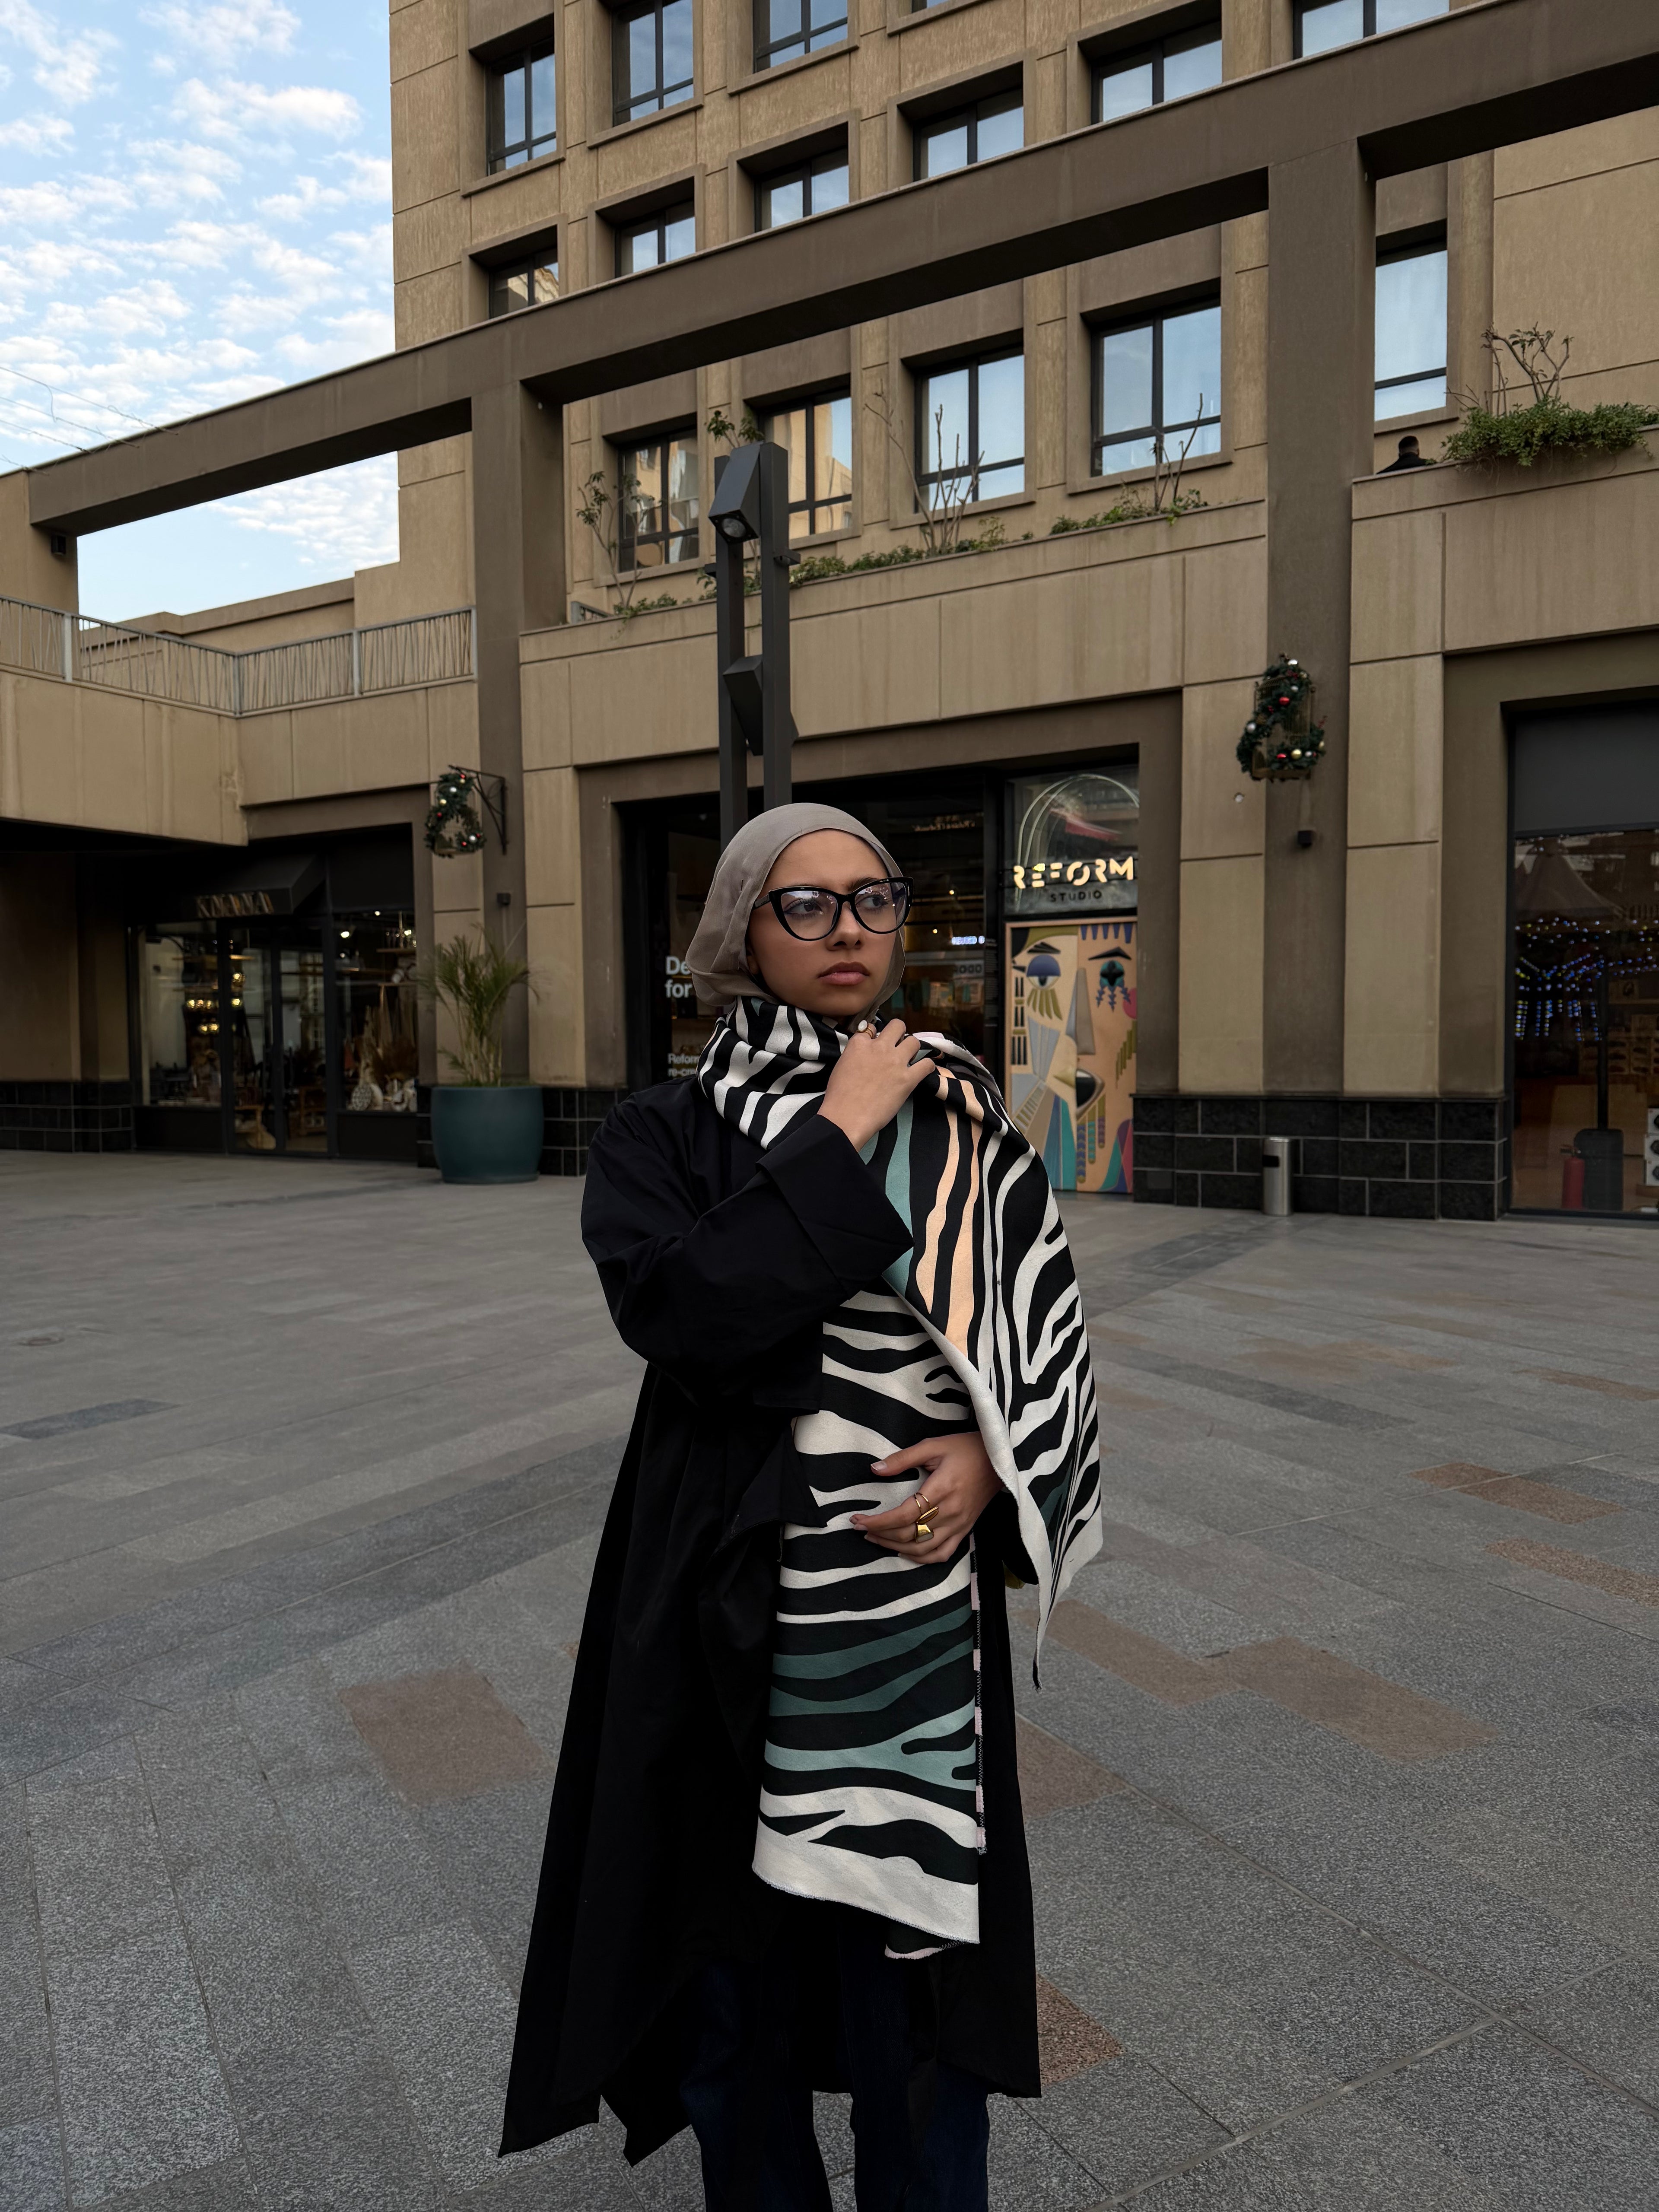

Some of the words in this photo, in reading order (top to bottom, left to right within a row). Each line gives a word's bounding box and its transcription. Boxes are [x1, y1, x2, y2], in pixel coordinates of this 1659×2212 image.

[1014, 855, 1133, 889] REFORM
[1051, 890, 1102, 902] STUDIO
[665, 955, 692, 976] De
[664, 979, 693, 998] for
